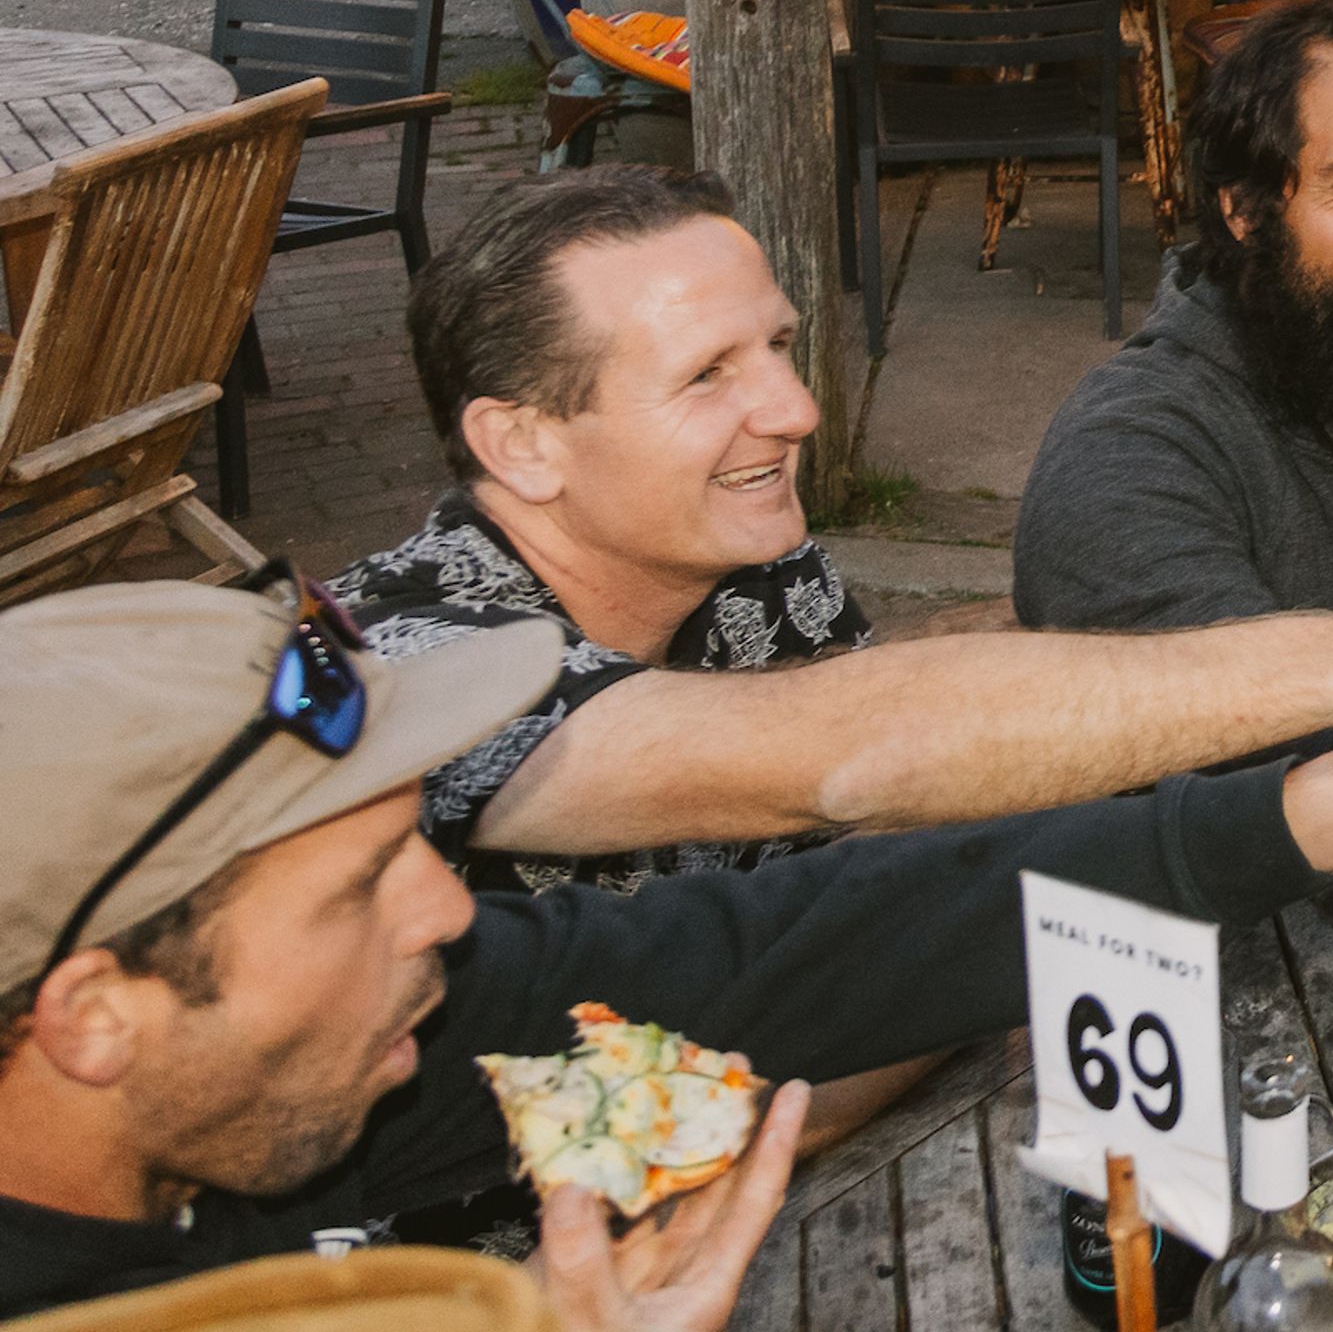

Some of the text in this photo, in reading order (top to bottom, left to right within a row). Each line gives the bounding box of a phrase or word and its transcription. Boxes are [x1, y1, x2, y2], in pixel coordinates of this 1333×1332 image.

[1038, 916, 1203, 980] MEAL FOR TWO?
[1067, 992, 1184, 1132] 69
